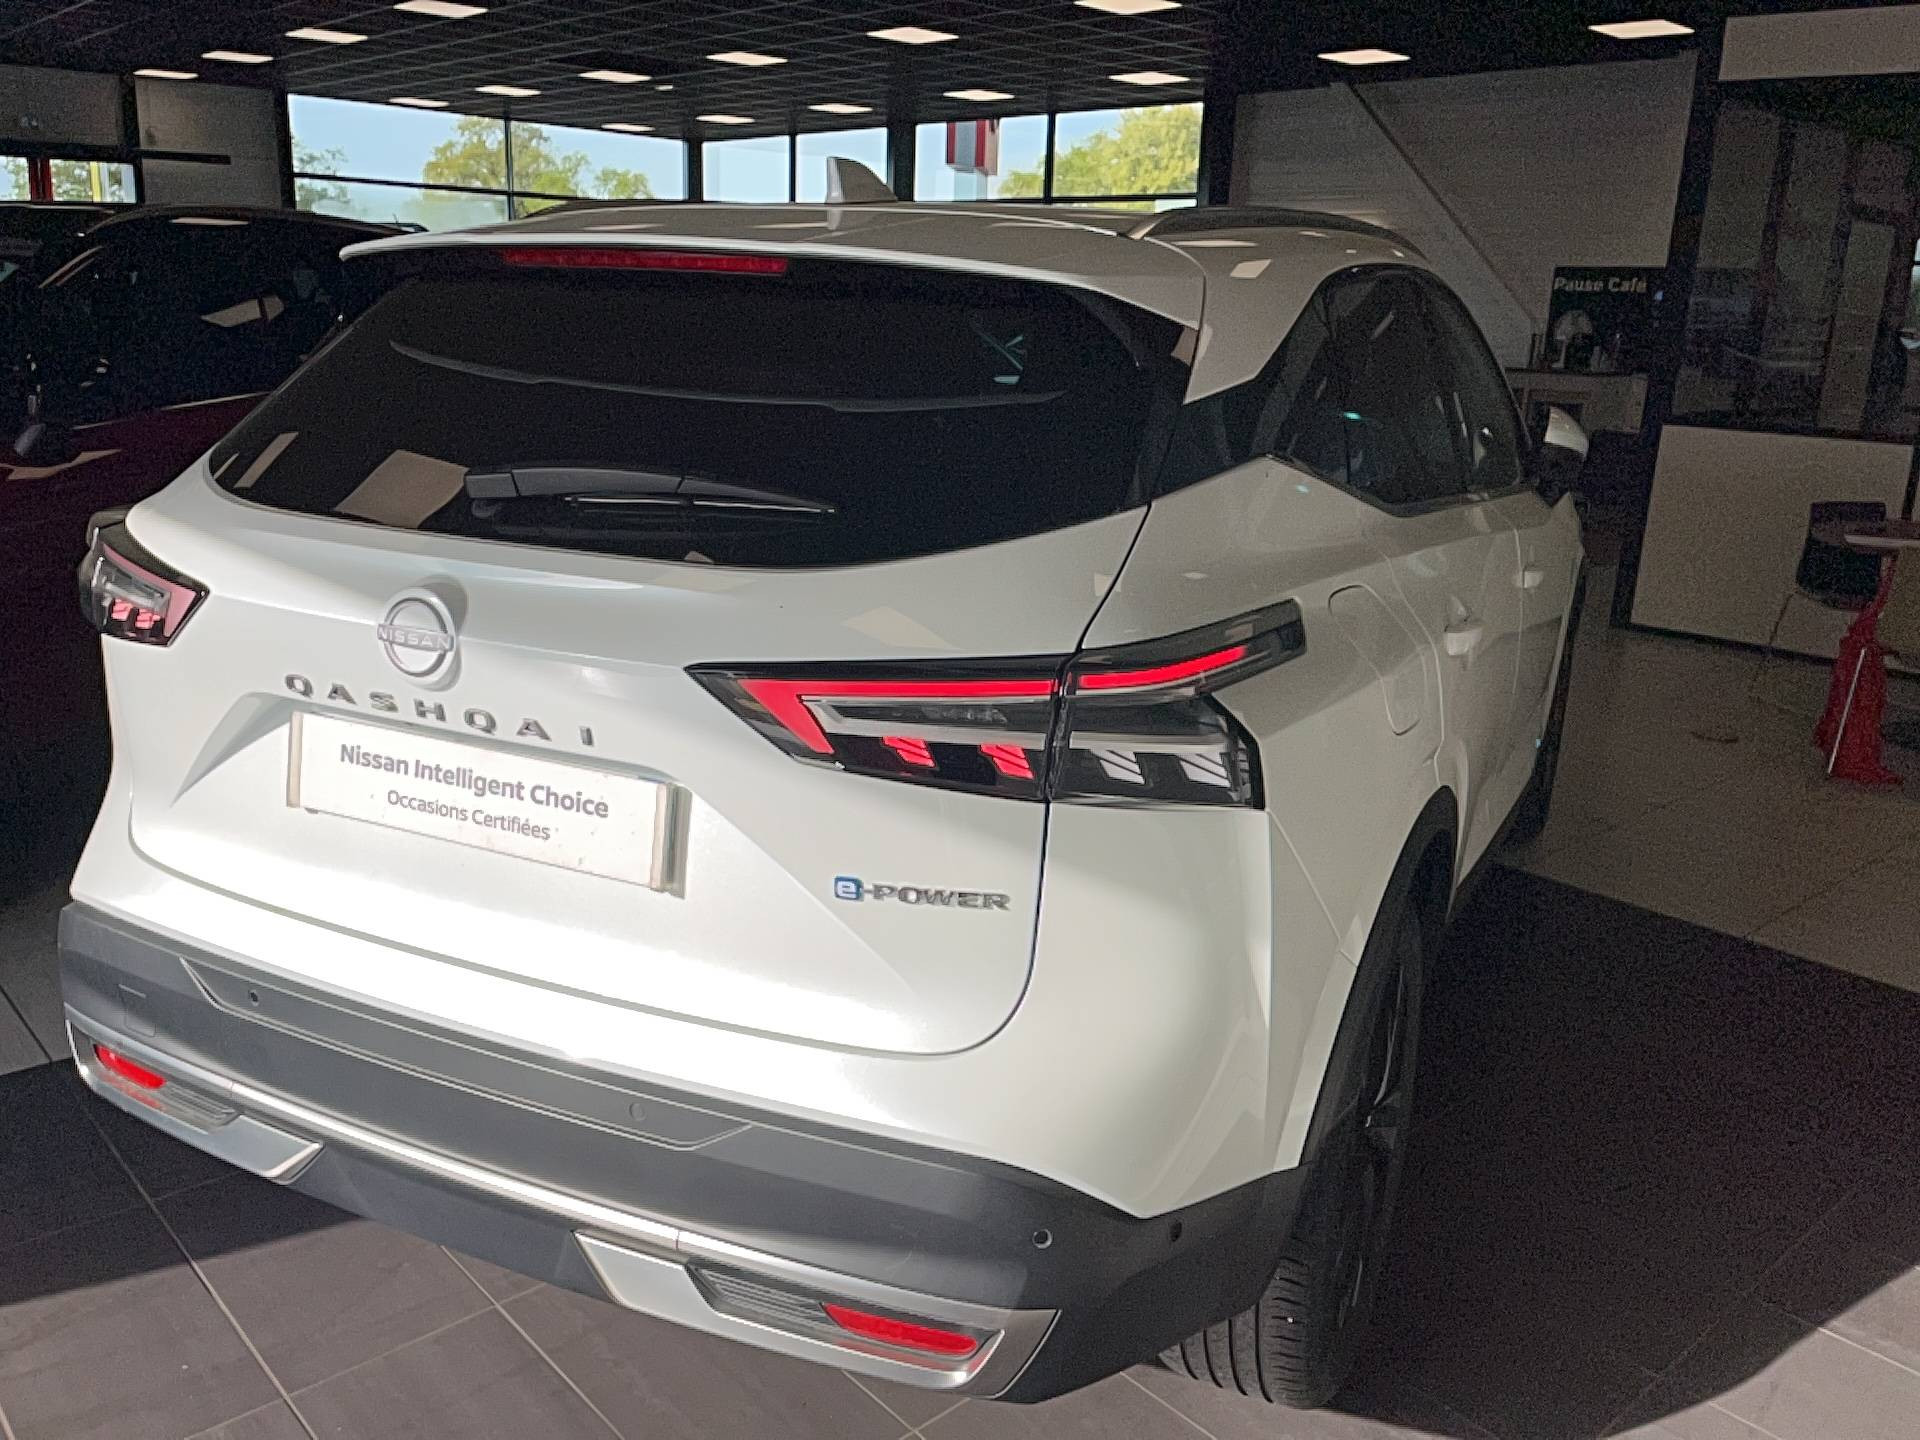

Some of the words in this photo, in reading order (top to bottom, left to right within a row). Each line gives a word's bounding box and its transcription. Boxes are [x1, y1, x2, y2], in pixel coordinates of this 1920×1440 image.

[1553, 276, 1604, 292] Pause
[1608, 276, 1648, 293] Café
[378, 624, 450, 653] NISSAN
[284, 673, 595, 747] QASHQAI
[340, 743, 409, 776] Nissan
[414, 759, 525, 801] Intelligent
[530, 784, 609, 819] Choice
[387, 789, 468, 822] Occasions
[471, 808, 551, 841] Certifiées
[834, 875, 1011, 911] e-POWER
